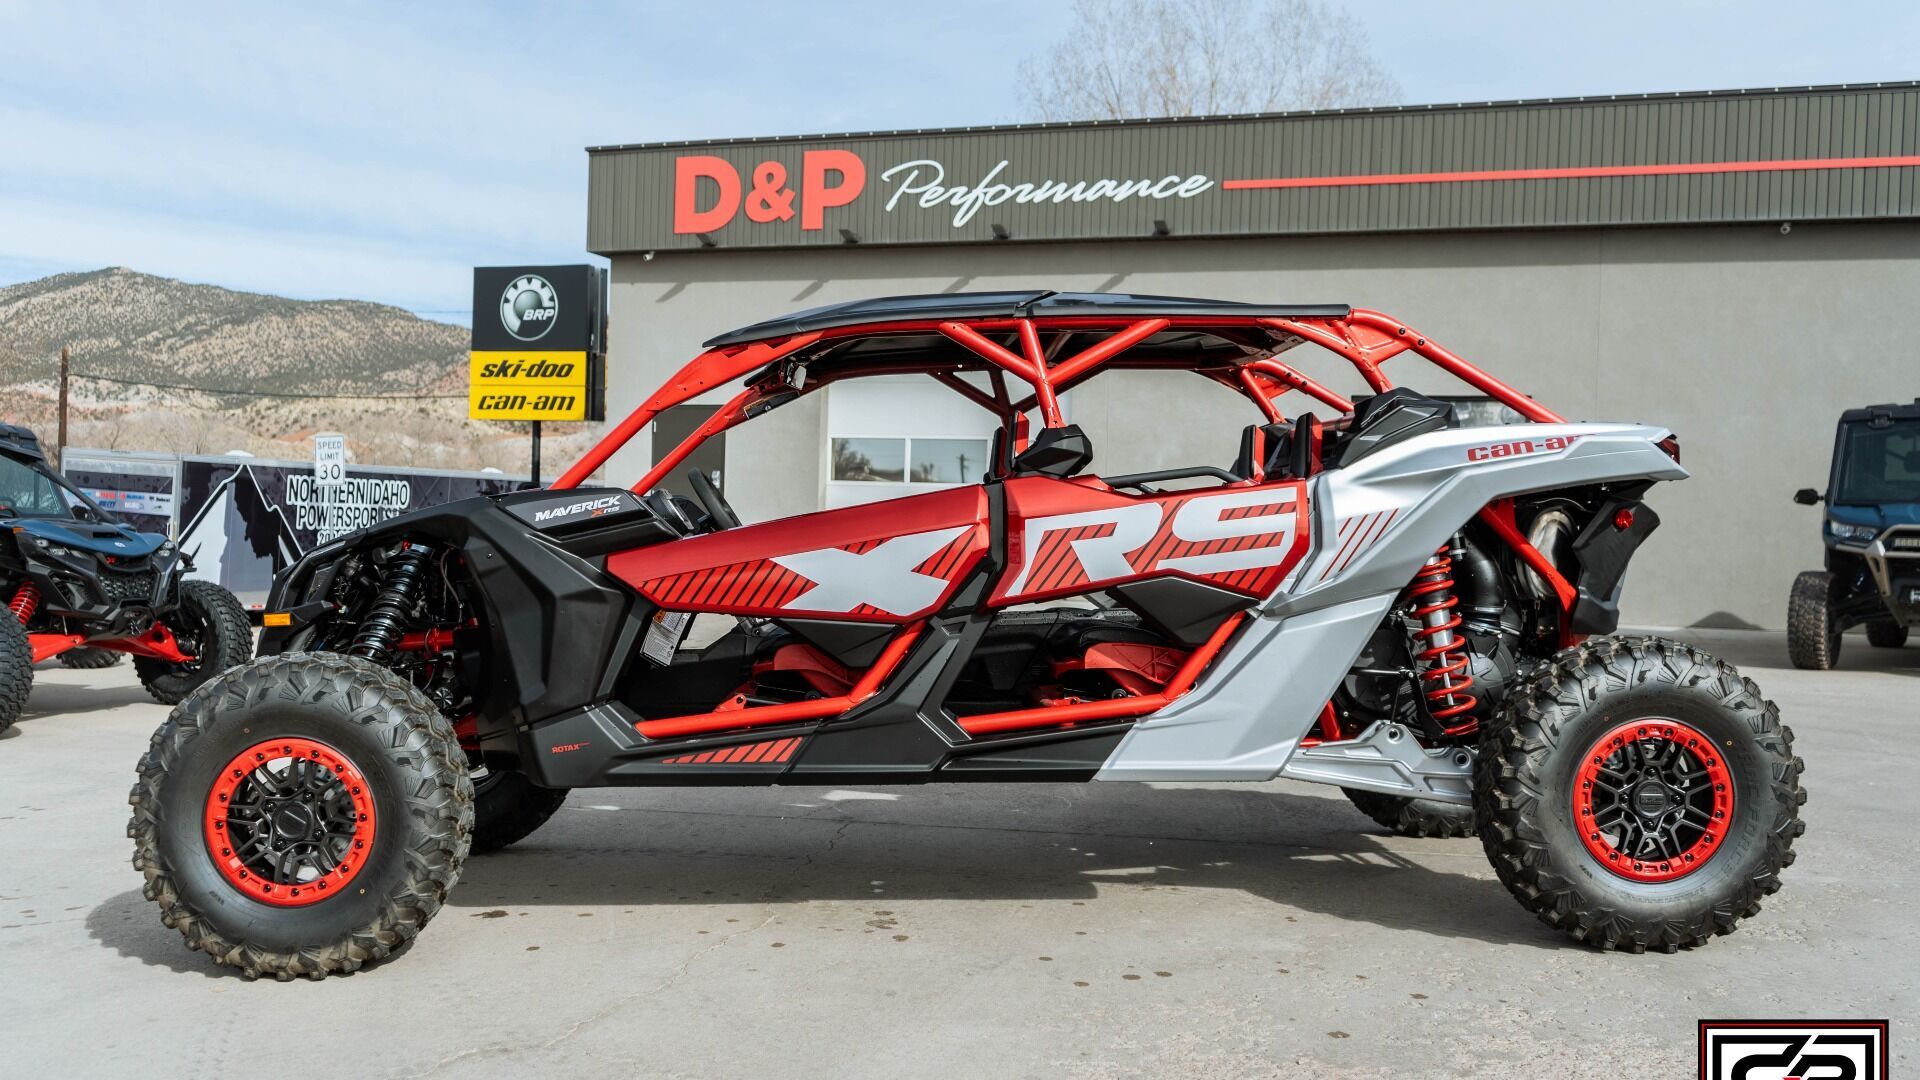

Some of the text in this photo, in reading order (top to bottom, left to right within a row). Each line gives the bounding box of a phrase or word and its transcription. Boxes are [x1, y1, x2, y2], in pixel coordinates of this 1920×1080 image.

[673, 149, 1215, 235] D&P Performance
[522, 308, 555, 321] BRP
[479, 359, 575, 378] ski-doo
[477, 394, 576, 411] can-am
[317, 440, 342, 450] SPEED
[1466, 434, 1583, 462] can-a
[320, 452, 340, 461] LIMIT
[319, 463, 341, 480] 30
[298, 505, 394, 529] POWRSPORS
[535, 495, 622, 522] MAVERICK
[551, 743, 580, 753] ROTAX
